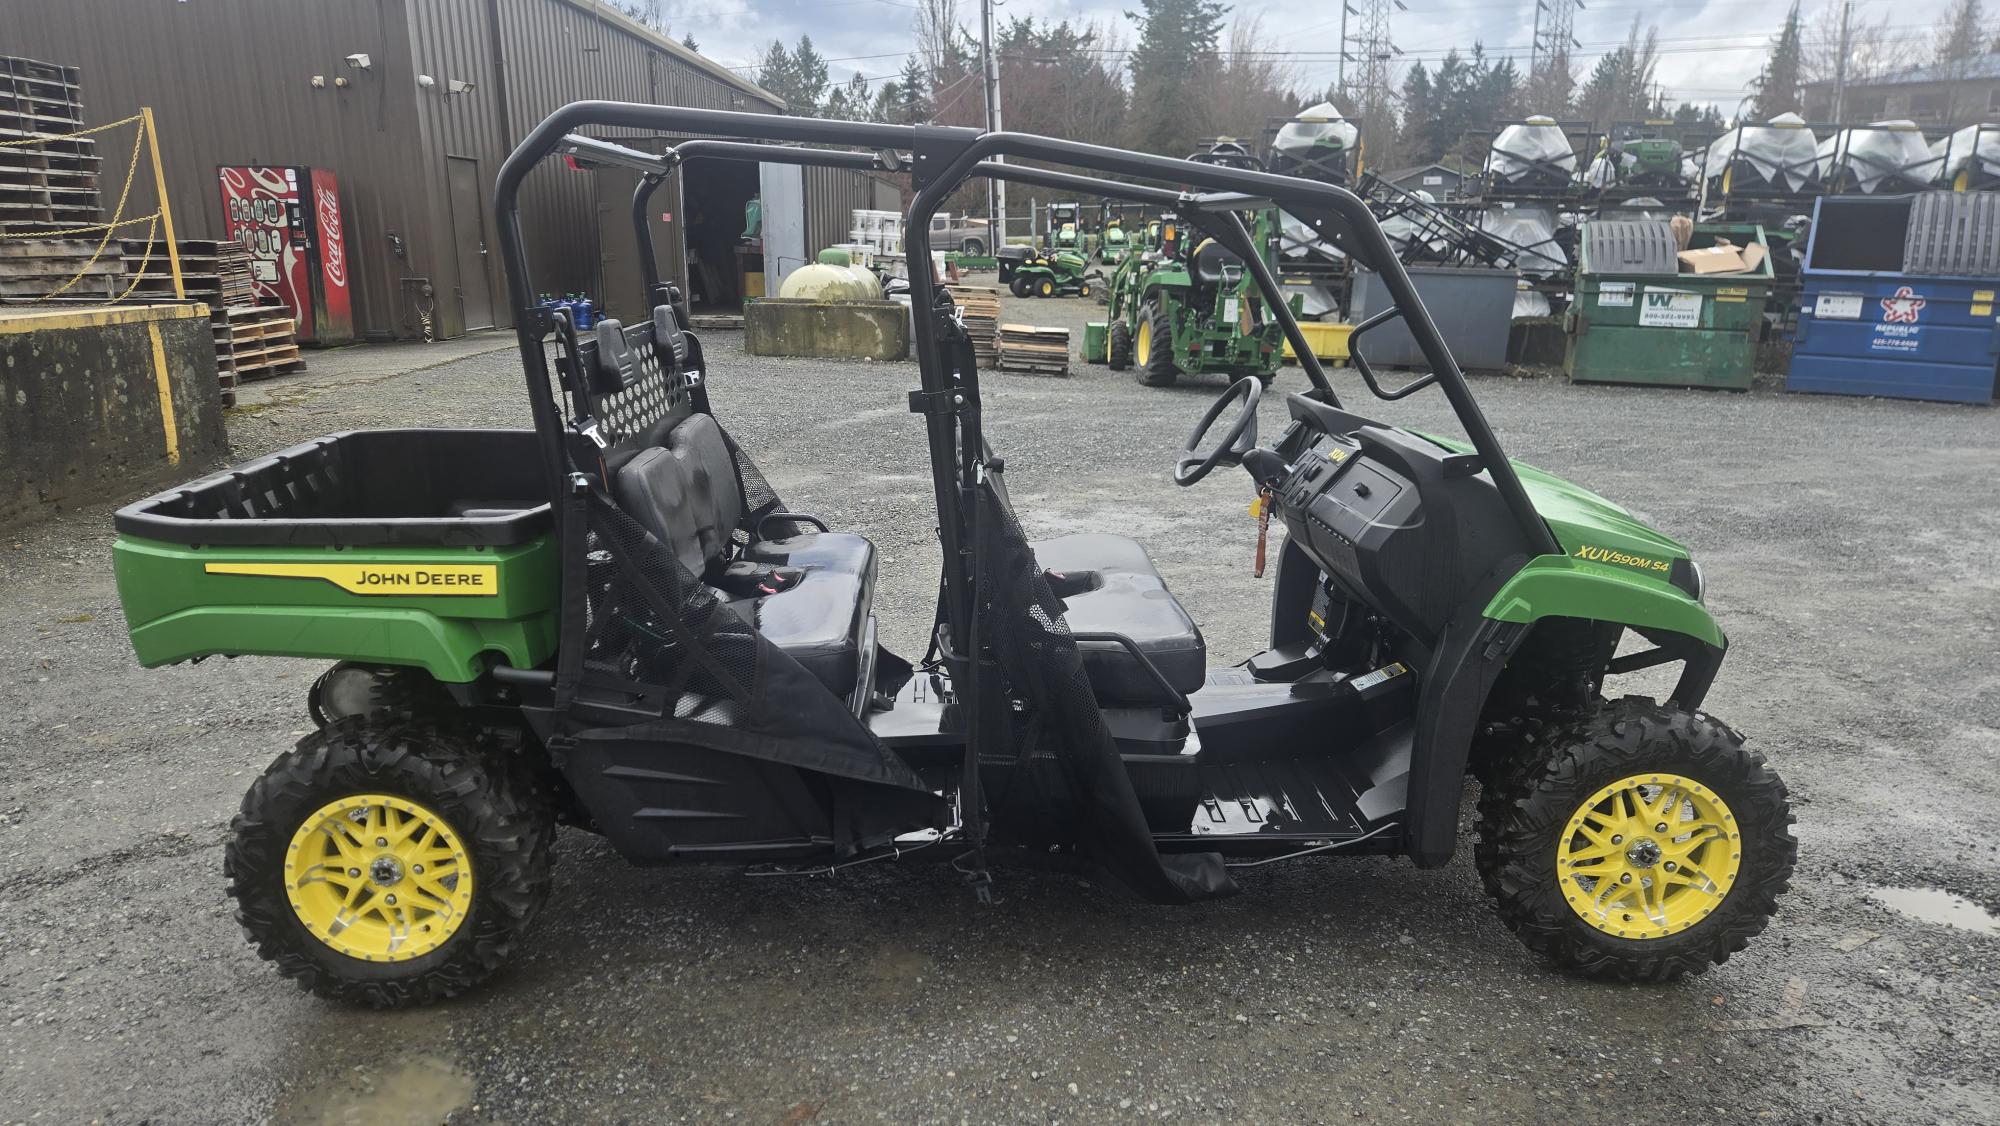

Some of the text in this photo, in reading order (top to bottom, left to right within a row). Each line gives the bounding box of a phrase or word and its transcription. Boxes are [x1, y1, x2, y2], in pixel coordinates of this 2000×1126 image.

[1875, 324, 1919, 334] REPUBLIC
[1328, 447, 1347, 462] XUV
[1574, 545, 1669, 571] XUV590M S4
[356, 571, 483, 586] JOHN DEERE
